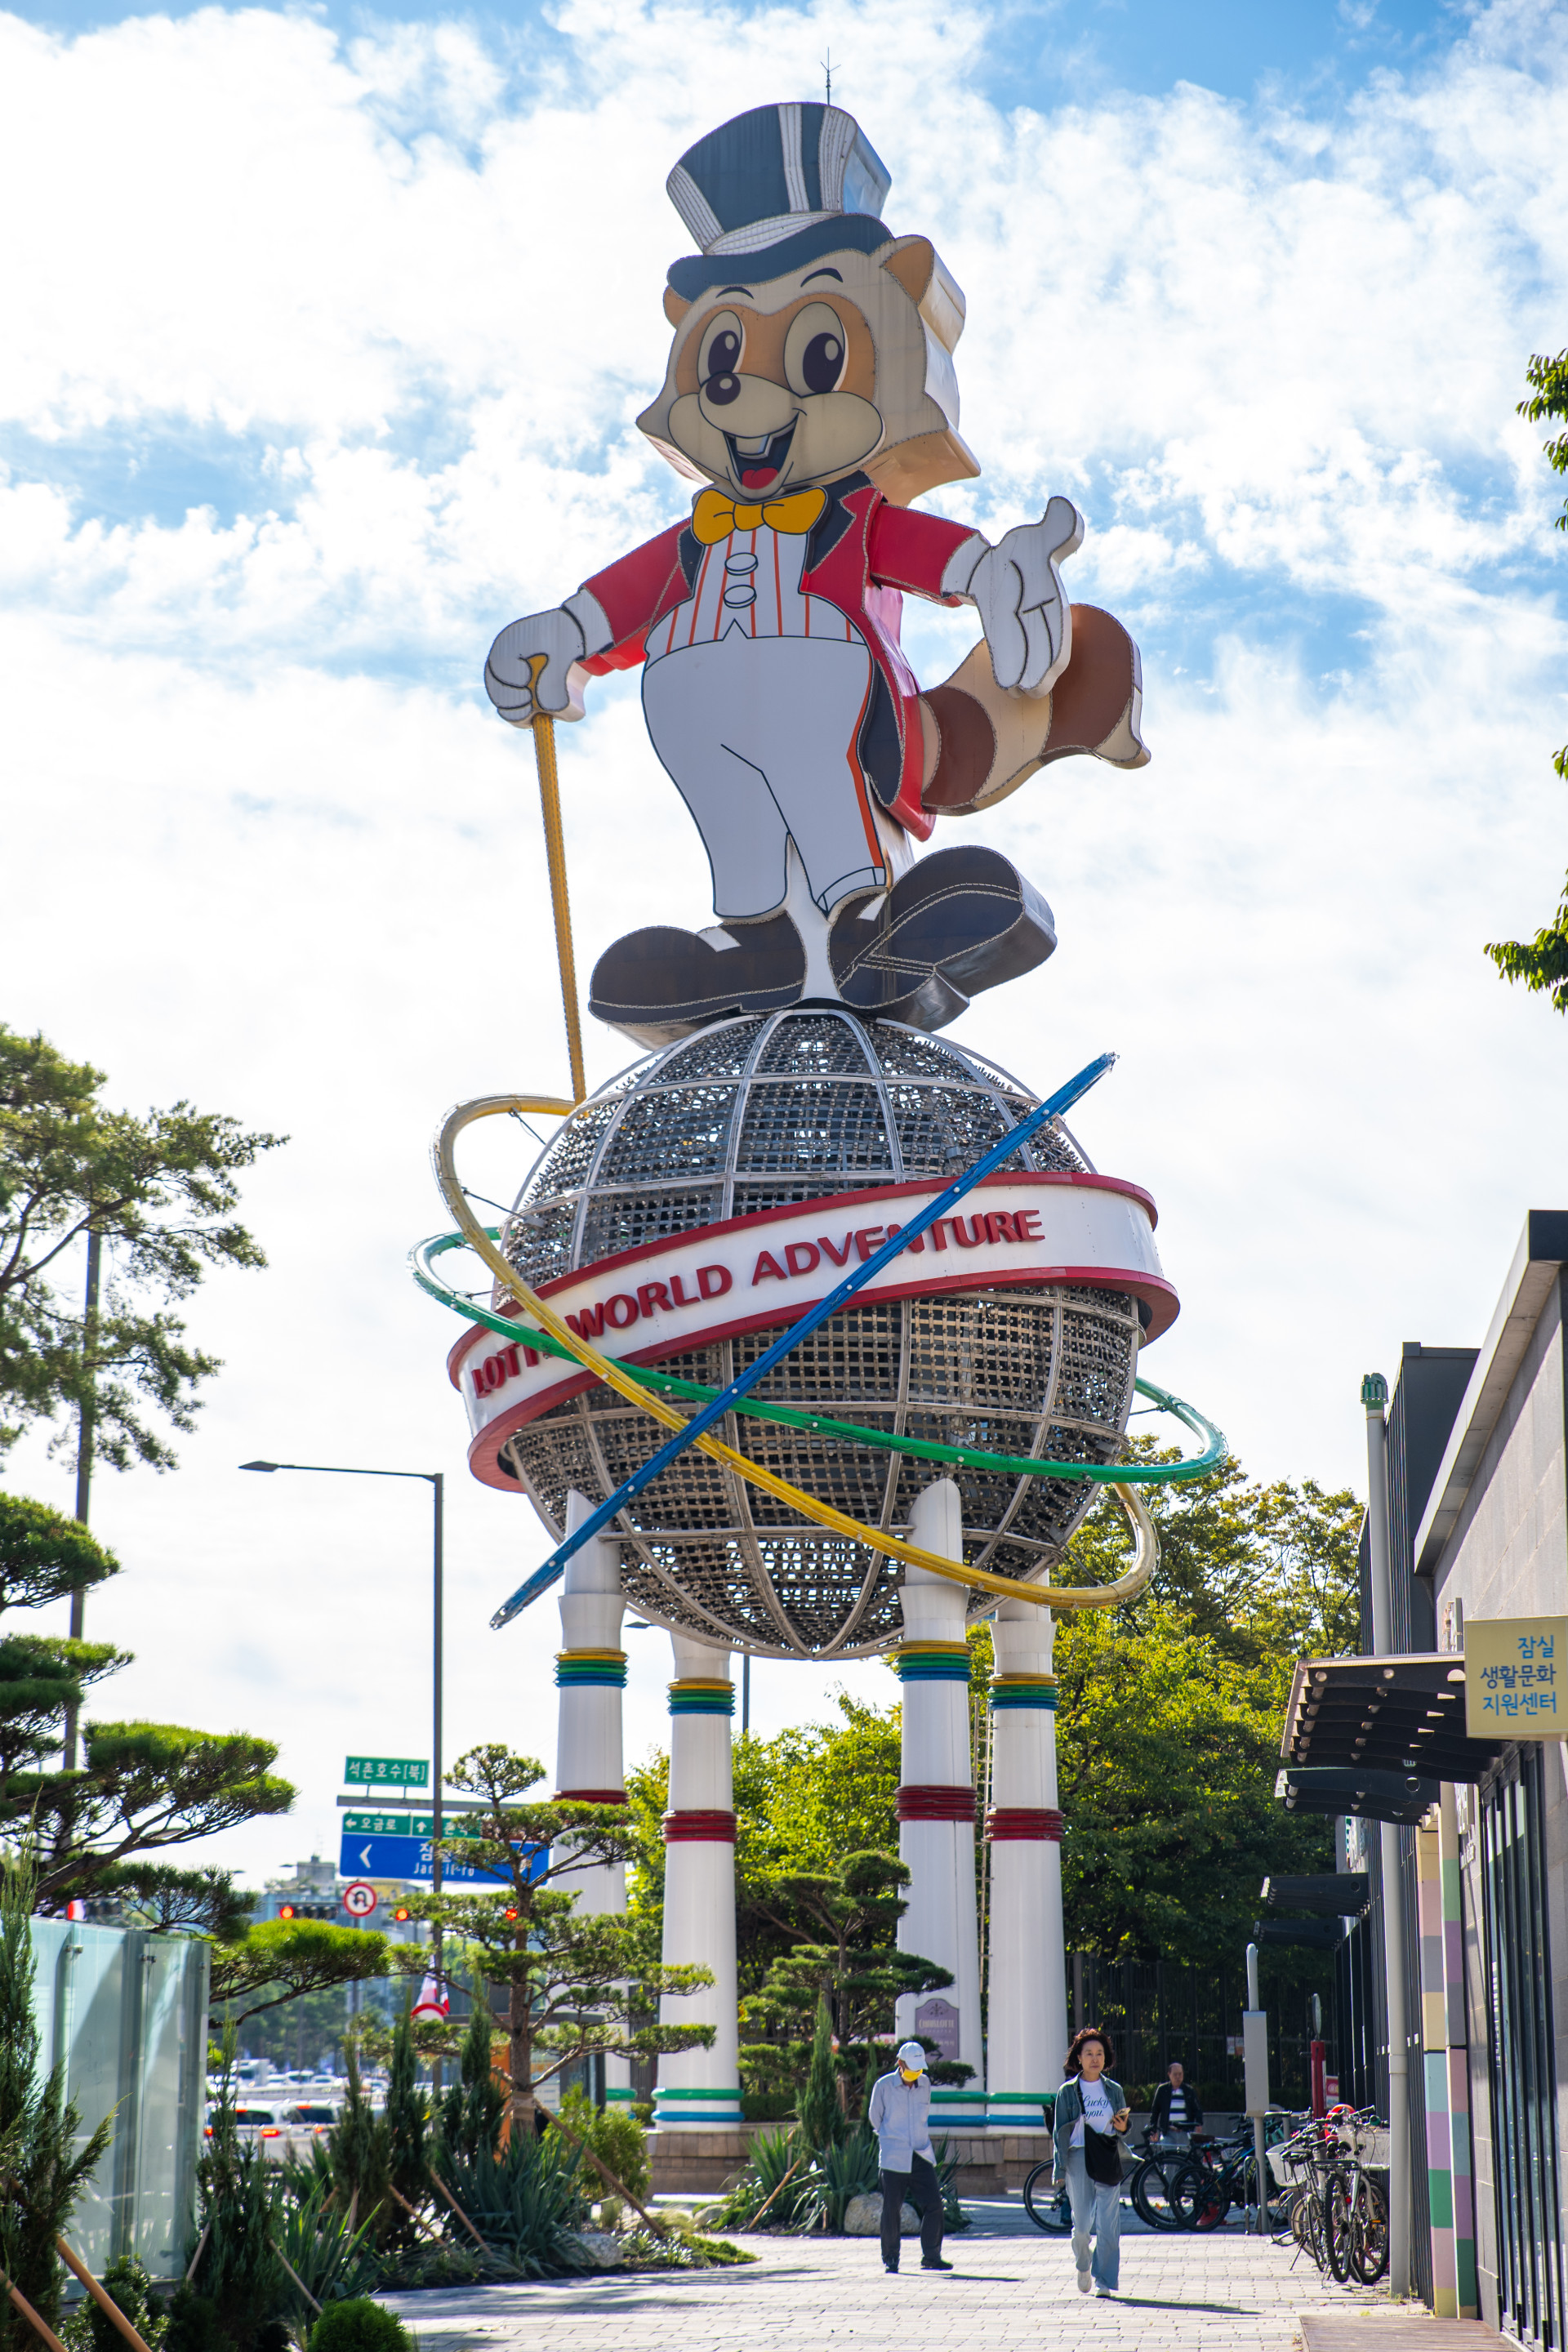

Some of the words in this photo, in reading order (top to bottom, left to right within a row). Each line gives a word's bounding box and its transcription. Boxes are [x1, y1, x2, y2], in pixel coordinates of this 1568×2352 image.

[471, 1327, 557, 1399] LOTT
[564, 1263, 733, 1342] WORLD
[1517, 1634, 1555, 1659] 잠실
[1479, 1663, 1557, 1690] 생활문화
[1482, 1690, 1557, 1717] 지원센터
[348, 1761, 425, 1782] 석촌호수[북]
[360, 1817, 397, 1832] 오금로
[1083, 2095, 1109, 2109] Lucky
[1085, 2109, 1104, 2120] you.
